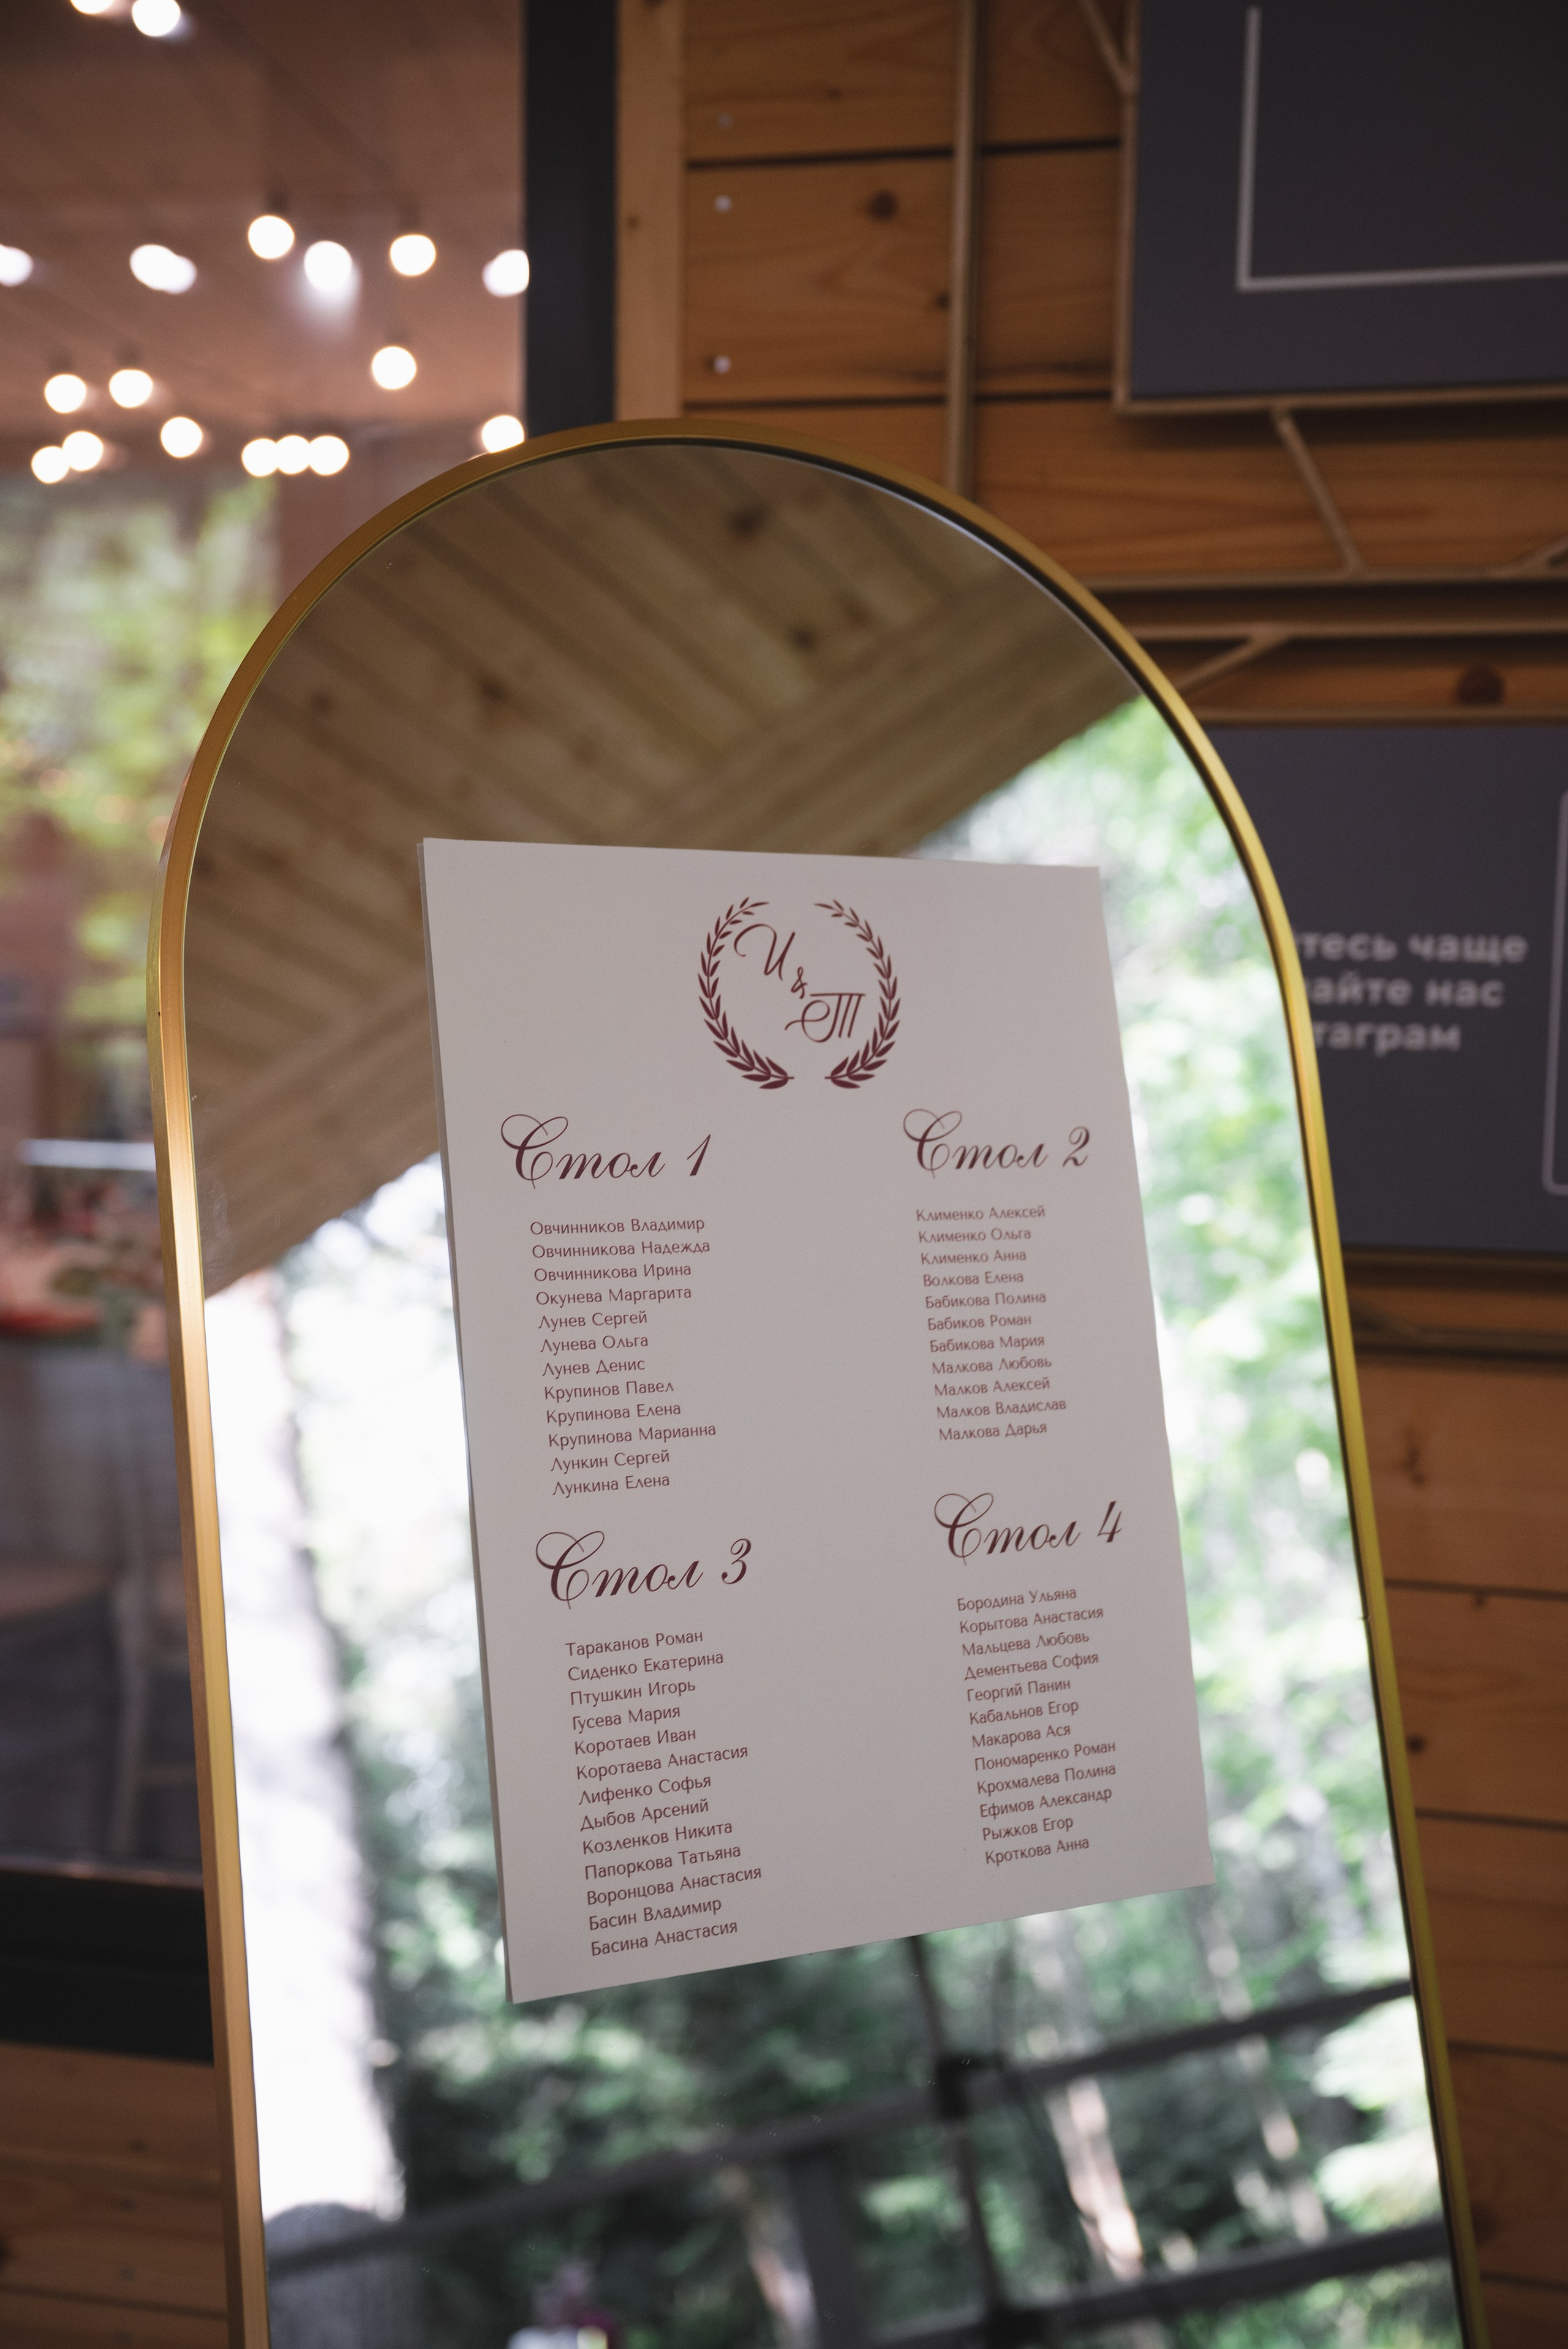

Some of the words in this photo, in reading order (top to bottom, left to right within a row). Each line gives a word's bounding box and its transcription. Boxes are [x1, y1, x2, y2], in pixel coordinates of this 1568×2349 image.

[1295, 932, 1398, 961] тесь
[1408, 933, 1528, 966] чаще
[790, 966, 808, 1000] &
[1306, 970, 1412, 1006] айте
[1425, 979, 1504, 1008] нас
[784, 992, 866, 1043] Т
[500, 1114, 666, 1190] Стол
[687, 1134, 711, 1177] 1
[903, 1109, 1048, 1178] Стол
[1062, 1126, 1090, 1167] 2
[916, 1210, 984, 1221] Клименко
[989, 1205, 1045, 1218] Алексей
[530, 1221, 625, 1235] Овчинников
[631, 1218, 705, 1233] Владимир
[919, 1231, 986, 1243] Клименко
[990, 1228, 1031, 1240] Ольга
[532, 1245, 635, 1258] Овчинникова
[641, 1241, 710, 1255] Надежда
[921, 1253, 989, 1265] Клименко
[994, 1250, 1027, 1261] Анна
[534, 1268, 637, 1281] Овчинникова
[644, 1264, 691, 1280] Ирина
[923, 1274, 979, 1287] Волкова
[985, 1271, 1023, 1284] Елена
[536, 1291, 602, 1308] Окунева
[609, 1288, 692, 1305] Маргарита
[925, 1295, 990, 1309] Бабикова
[995, 1292, 1046, 1304] Полина
[538, 1315, 586, 1332] Лунев
[592, 1310, 647, 1329] Сергей
[927, 1317, 985, 1330] Бабиков
[990, 1314, 1031, 1326] Роман
[540, 1339, 596, 1356] Лунева
[602, 1335, 648, 1349] Ольга
[930, 1339, 994, 1352] Бабикова
[1000, 1336, 1044, 1351] Мария
[542, 1363, 590, 1379] Лунев
[596, 1359, 645, 1374] Денис
[932, 1362, 993, 1374] Малкова
[998, 1356, 1052, 1370] Любовь
[545, 1386, 620, 1403] Крупинов
[626, 1381, 674, 1394] Павел
[934, 1384, 988, 1396] Малков
[993, 1377, 1050, 1392] Алексей
[546, 1408, 630, 1427] Крупинова
[636, 1403, 681, 1417] Елена
[937, 1406, 990, 1418] Малков
[995, 1400, 1066, 1414] Владислав
[548, 1431, 632, 1450] Крупинова
[639, 1425, 716, 1443] Марианна
[939, 1427, 1000, 1440] Малкова
[1005, 1423, 1047, 1438] Дарья
[551, 1457, 608, 1474] Лункин
[614, 1449, 669, 1469] Сергей
[552, 1480, 619, 1498] Лункина
[625, 1476, 669, 1489] Елена
[933, 1493, 1080, 1566] Стол
[1097, 1500, 1122, 1543] 4
[535, 1531, 704, 1610] Стол
[721, 1538, 752, 1585] 3
[957, 1595, 1024, 1613] Бородина
[1029, 1589, 1077, 1604] Ульяна
[960, 1617, 1028, 1635] Корытова
[1033, 1608, 1104, 1624] Анастасия
[565, 1638, 649, 1659] Тараканов
[655, 1632, 703, 1646] Роман
[962, 1639, 1030, 1656] Мальцева
[1036, 1632, 1090, 1648] Любовь
[568, 1664, 638, 1681] Сиденко
[644, 1653, 723, 1672] Екатерина
[964, 1660, 1047, 1681] Дементьева
[1052, 1653, 1099, 1669] София
[570, 1687, 642, 1708] Птушкин
[649, 1681, 696, 1697] Игорь
[967, 1683, 1022, 1703] Георгий
[1028, 1680, 1071, 1694] Панин
[573, 1714, 622, 1734] Гусева
[628, 1707, 680, 1724] Мария
[970, 1706, 1043, 1725] Кабальнов
[1048, 1701, 1079, 1716] Егор
[575, 1736, 651, 1757] Коротаев
[657, 1729, 696, 1744] Иван
[972, 1730, 1041, 1748] Макарова
[1046, 1725, 1071, 1737] Ася
[576, 1759, 662, 1781] Коротаева
[668, 1747, 748, 1767] Анастасия
[974, 1749, 1069, 1771] Пономаренко
[1074, 1743, 1115, 1757] Роман
[578, 1785, 653, 1805] Лифенко
[658, 1776, 711, 1794] Софья
[977, 1773, 1060, 1797] Крохмалева
[1065, 1765, 1116, 1781] Полина
[580, 1811, 635, 1832] Дыбов
[642, 1798, 709, 1823] Арсений
[979, 1801, 1035, 1820] Ефимов
[1039, 1789, 1112, 1808] Александр
[582, 1833, 669, 1855] Козленков
[675, 1823, 733, 1841] Никита
[982, 1823, 1038, 1841] Рыжков
[1042, 1818, 1074, 1832] Егор
[585, 1857, 673, 1880] Папоркова
[677, 1846, 741, 1865] Татьяна
[985, 1845, 1051, 1867] Кроткова
[1057, 1839, 1090, 1852] Анна
[587, 1882, 674, 1907] Воронцова
[680, 1868, 761, 1890] Анастасия
[589, 1913, 637, 1931] Басин
[643, 1899, 722, 1921] Владимир
[591, 1937, 648, 1956] Басина
[655, 1922, 737, 1945] Анастасия
